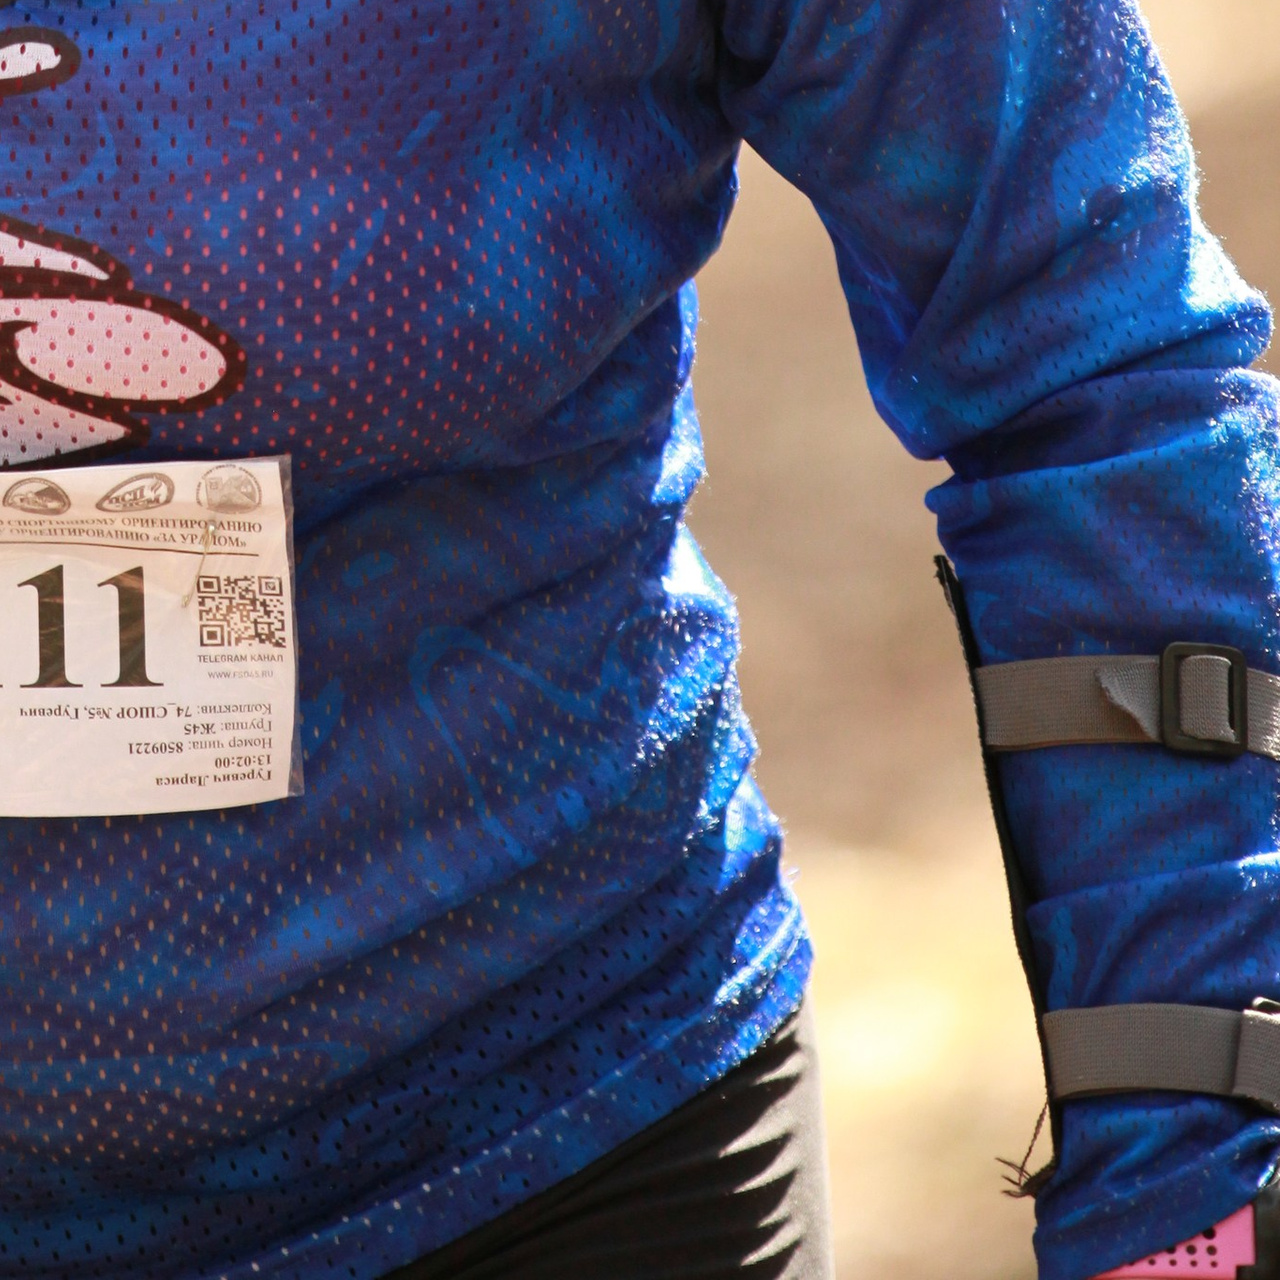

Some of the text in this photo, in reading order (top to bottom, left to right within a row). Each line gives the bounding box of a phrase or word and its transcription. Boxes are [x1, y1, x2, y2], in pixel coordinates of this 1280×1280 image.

[197, 654, 284, 663] TELEGRAM КАНАЛ
[19, 704, 80, 721] Гуревич
[196, 703, 273, 715] Коллектив:
[183, 720, 273, 736] Группа: Ж45
[128, 737, 273, 756] Номер чипа: 8509221
[214, 753, 272, 769] 13:02:00
[155, 768, 273, 787] Гуревич Лариса
